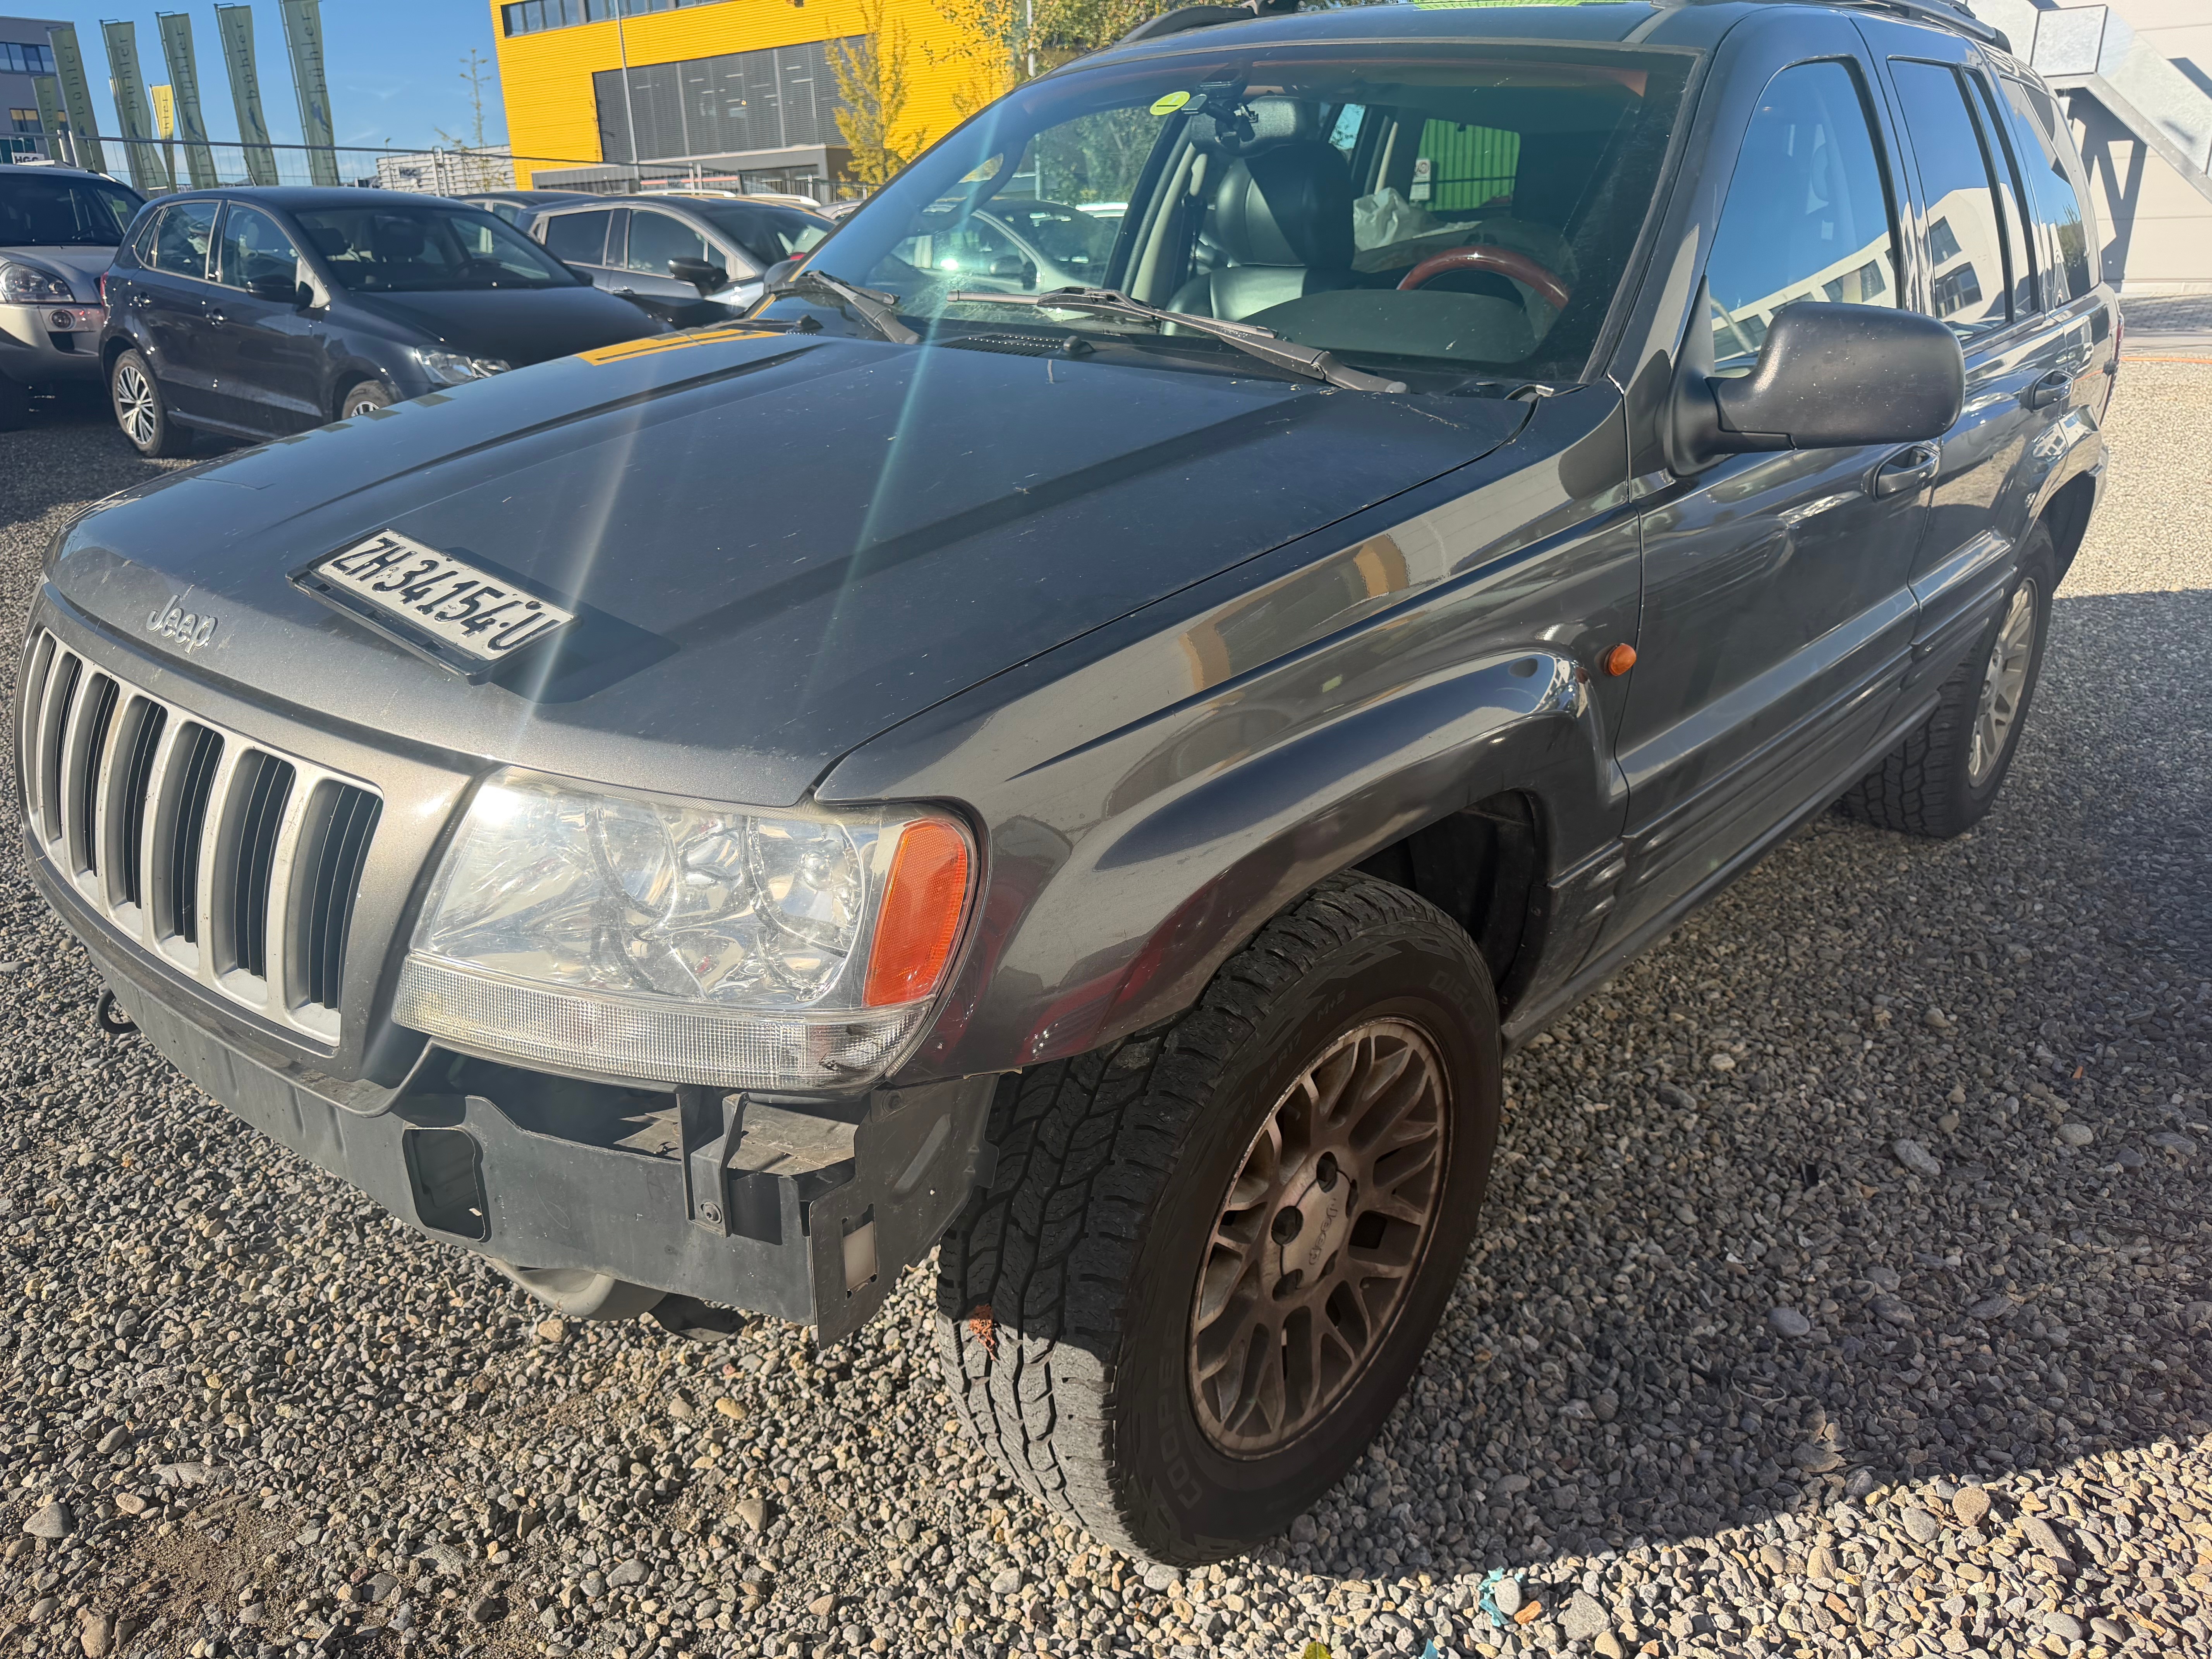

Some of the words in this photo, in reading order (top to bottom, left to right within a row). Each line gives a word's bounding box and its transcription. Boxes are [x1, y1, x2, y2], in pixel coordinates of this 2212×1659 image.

[175, 31, 198, 105] bühler
[236, 22, 258, 100] bühler
[301, 14, 327, 94] bühler
[146, 594, 218, 655] Jeep
[1317, 989, 1346, 1022] M+S
[1224, 1029, 1303, 1150] 235/65R17
[1309, 1205, 1338, 1265] Jeep
[1157, 1310, 1203, 1510] COOPER
